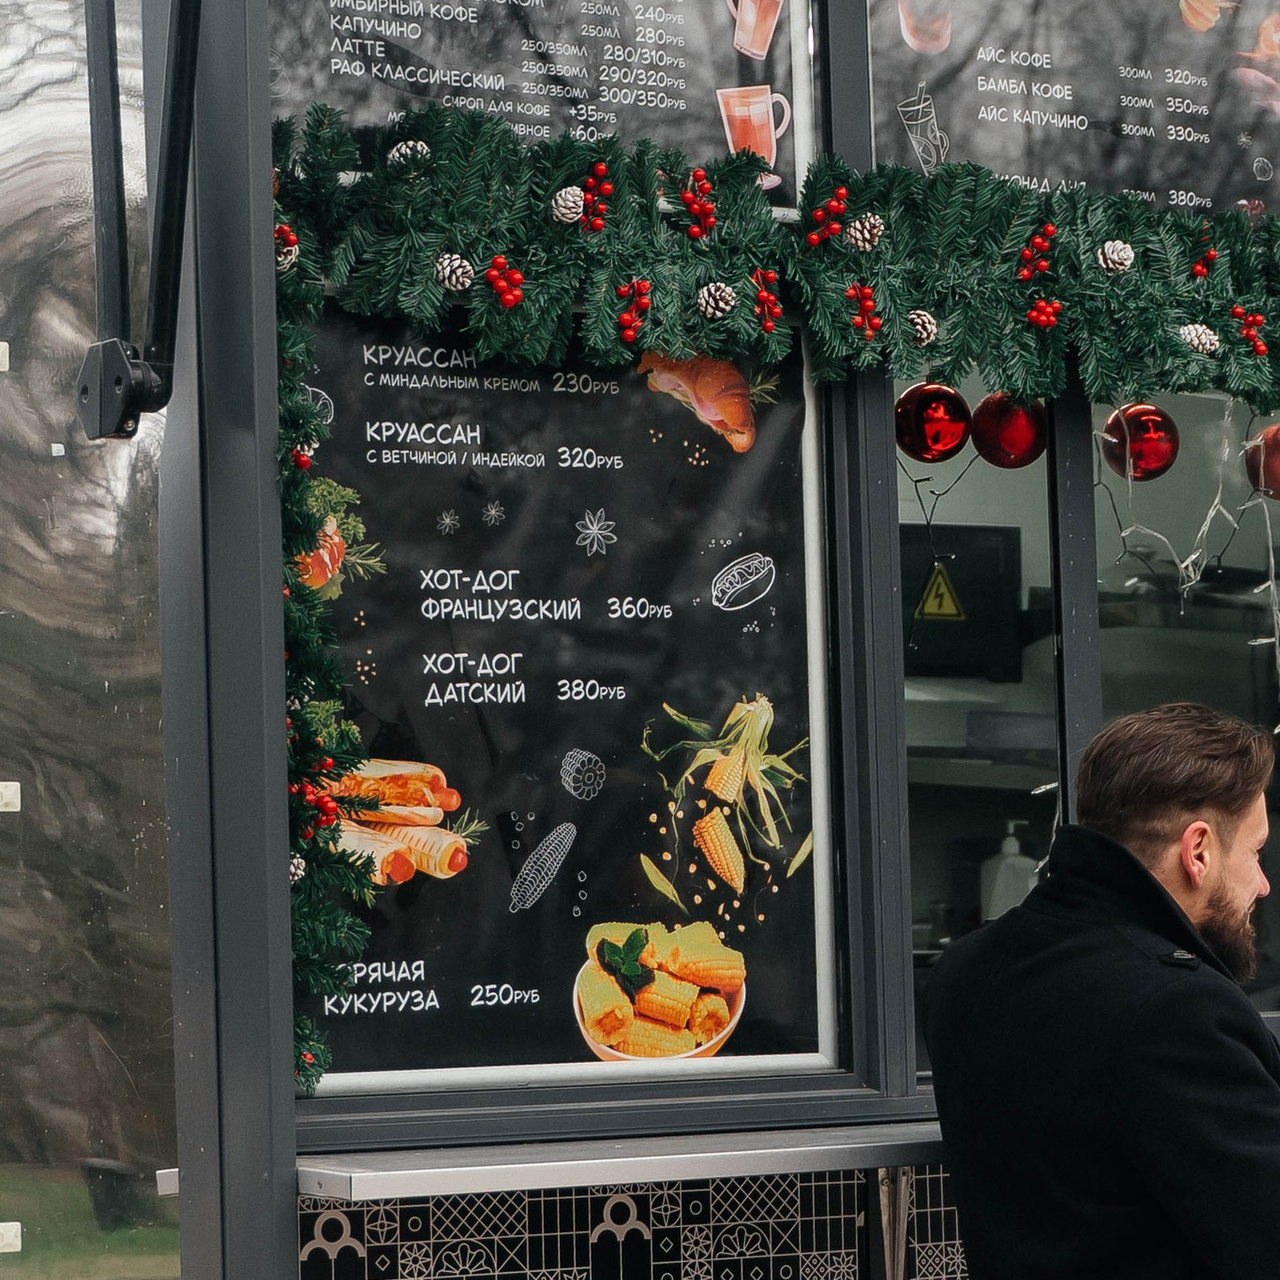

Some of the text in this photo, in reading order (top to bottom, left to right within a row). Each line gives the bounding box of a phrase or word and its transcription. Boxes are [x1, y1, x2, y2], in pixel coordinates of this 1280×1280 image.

[429, 3, 478, 23] КОФЕ
[581, 24, 621, 39] 250МЛ
[635, 26, 686, 47] 280РУБ
[580, 2, 620, 17] 250МЛ
[634, 4, 685, 25] 240РУБ
[330, 14, 686, 69] КАПУЧИНО 250/350МЛ 280/310РУБ
[330, 37, 687, 90] ЛАТТЕ 250/350МЛ 290/320РУБ
[977, 47, 1208, 87] АЙС КОФЕ 300МЛ 320РУБ
[330, 58, 687, 110] РАФ КЛАССИЧЕСКИЙ 250/350МЛ 300/350РУБ
[977, 76, 1210, 116] БАМБЛ КОФЕ 300МЛ 350РУБ
[487, 100, 513, 114] ДЛЯ
[516, 102, 550, 117] КОФЕ
[569, 104, 618, 124] +35РУБ
[978, 105, 1211, 144] АЙС КАПУЧИНО 300МЛ 330РУБ
[1168, 190, 1213, 208] 380РУБ
[363, 344, 477, 369] КРУАССАН
[364, 372, 620, 395] С МИНДАЛЬНЫМ КРЕМОМ 230РУБ
[365, 421, 481, 445] КРУАССАН
[366, 449, 377, 464] С
[382, 449, 457, 466] ВЕТЧИНОЙ
[472, 452, 546, 468] ИНДЕЙКОЙ
[557, 446, 624, 469] 320РУБ
[420, 569, 521, 594] ХОТ-ДОГ
[421, 596, 673, 622] ФРАНЦУЗСКИЙ 360РУБ
[422, 652, 523, 677] ХОТ-ДОГ
[424, 678, 626, 707] ДАТСКИЙ 380РУБ
[331, 960, 425, 984] РЯЧАЯ
[324, 983, 540, 1016] КУКУРУЗА 250РУБ
